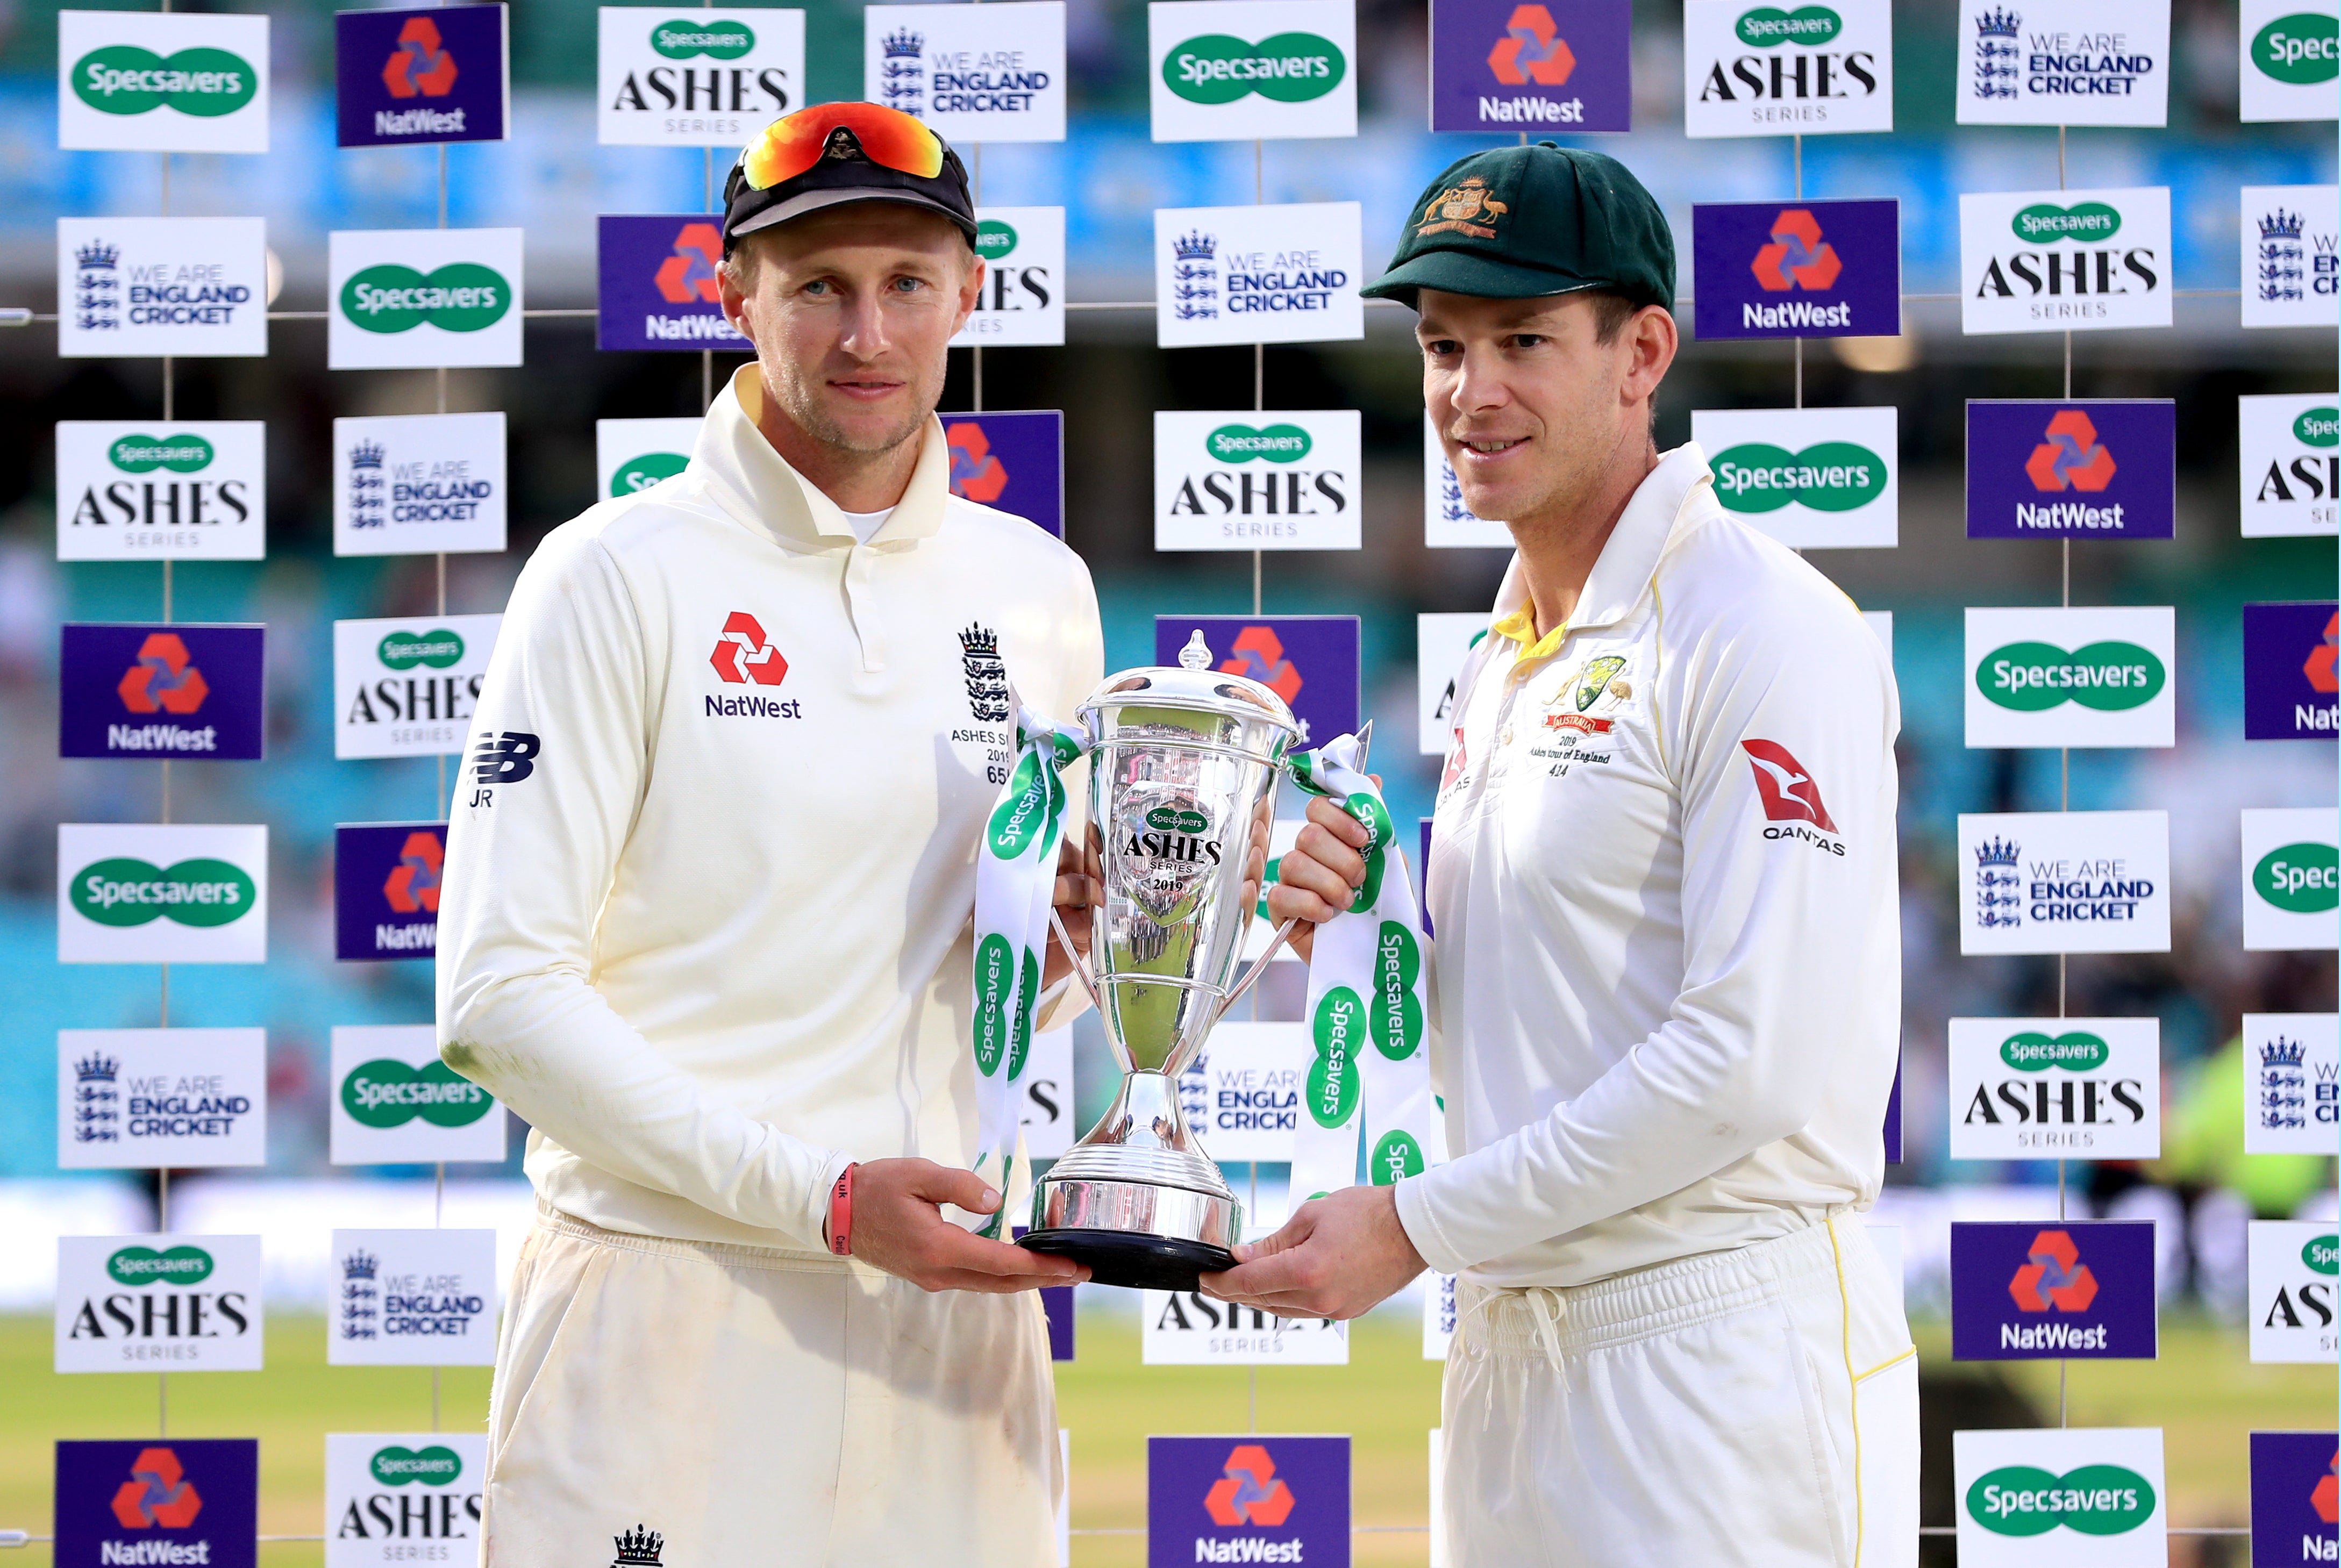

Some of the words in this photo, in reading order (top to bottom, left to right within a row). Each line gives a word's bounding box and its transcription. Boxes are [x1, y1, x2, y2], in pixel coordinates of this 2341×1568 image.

[1745, 18, 1832, 38] Specsavers
[659, 30, 746, 51] Specsavers
[2029, 33, 2068, 52] WE
[2078, 33, 2128, 52] ARE
[932, 53, 970, 70] WE
[975, 52, 1024, 69] ARE
[1178, 54, 1330, 87] Specsavers
[2029, 54, 2153, 74] ENGLAND
[87, 63, 241, 96] Specsavers
[933, 71, 1049, 91] ENGLAND
[1699, 53, 1876, 102] ASHES
[2028, 76, 2137, 95] CRICKET
[615, 68, 788, 112] ASHES
[934, 93, 1035, 112] CRICKET
[1479, 97, 1583, 123] NatWest
[375, 109, 465, 135] NatWest
[1752, 106, 1827, 123] SERIES
[665, 119, 740, 133] SERIES
[2021, 214, 2111, 234] Specsavers
[1226, 253, 1266, 271] WE
[1272, 250, 1320, 269] ARE
[128, 264, 167, 283] WE
[174, 264, 223, 282] ARE
[1227, 270, 1346, 291] ENGLAND
[1977, 247, 2157, 298] ASHES
[129, 285, 251, 303] ENGLAND
[355, 283, 496, 314] Specsavers
[1227, 293, 1332, 312] CRICKET
[129, 308, 233, 325] CRICKET
[1743, 302, 1850, 328] NatWest
[2031, 302, 2107, 319] SERIES
[646, 314, 753, 340] NatWes
[117, 443, 206, 463] Specsavers
[1214, 432, 1303, 454] Specsavers
[392, 463, 423, 480] WE
[429, 461, 468, 478] ARE
[1721, 462, 1869, 495] Specsavers
[393, 480, 490, 501] ENGLAND
[1171, 470, 1345, 515] ASHES
[72, 480, 248, 525] ASHES
[394, 503, 479, 523] CRICKET
[2016, 503, 2124, 530] NatWest
[1223, 522, 1297, 537] SERIES
[125, 533, 199, 548] SERIES
[384, 640, 459, 658] Specsavers
[1994, 660, 2147, 693] Specsavers
[705, 695, 802, 720] NatWest
[1555, 715, 1594, 733] AUSTRALIA
[108, 725, 217, 751] NatWest
[391, 727, 453, 744] SERIES
[952, 730, 995, 743] ASHES
[1559, 736, 1576, 746] 2019
[1548, 748, 1562, 758] tour
[1564, 751, 1574, 760] of
[1574, 751, 1611, 764] England
[987, 766, 1009, 785] 65
[1550, 764, 1568, 777] 414
[469, 789, 493, 807] JR
[997, 767, 1046, 847] Specsave
[1152, 813, 1202, 827] Specsavers
[1123, 833, 1222, 866] ASHES
[1763, 827, 1846, 857] QANTAS
[1150, 861, 1193, 874] SERIES
[2030, 861, 2070, 879] WE
[2077, 860, 2126, 879] ARE
[87, 876, 240, 910] Specsavers
[1153, 879, 1183, 892] 2019
[2030, 880, 2153, 899] ENGLAND
[2030, 902, 2139, 920] CRICKET
[376, 923, 437, 950] NatW
[1383, 934, 1404, 1047] Specsavers
[981, 947, 1001, 1063] Specsavers
[1322, 1000, 1353, 1116] Specsavers
[2010, 1042, 2100, 1064] Specsavers
[128, 1076, 167, 1096] WE
[174, 1075, 223, 1094] ARE
[1217, 1070, 1257, 1087] WE
[1265, 1070, 1300, 1087] AR
[354, 1078, 482, 1111] Specsavers
[1219, 1091, 1297, 1108] ENGLA
[1964, 1079, 2144, 1126] ASHES
[128, 1098, 251, 1115] ENGLAND
[129, 1118, 234, 1136] CRICKET
[1218, 1112, 1296, 1129] CRICK
[2017, 1131, 2094, 1148] SERIES
[116, 1255, 205, 1275] Specsavers
[385, 1276, 416, 1292] WE
[423, 1275, 462, 1292] ARE
[385, 1295, 482, 1314] ENGLAND
[69, 1292, 248, 1338] ASHES
[385, 1317, 469, 1336] CRICKET
[2001, 1323, 2106, 1350] NatWest
[122, 1344, 198, 1361] SERIES
[1208, 1337, 1283, 1352] SERIES
[377, 1456, 455, 1476] Specsavers
[1984, 1485, 2137, 1517] Specsavers
[102, 1540, 210, 1565] NatWest
[383, 1545, 449, 1561] SERIES
[1196, 1537, 1303, 1564] NatWest
